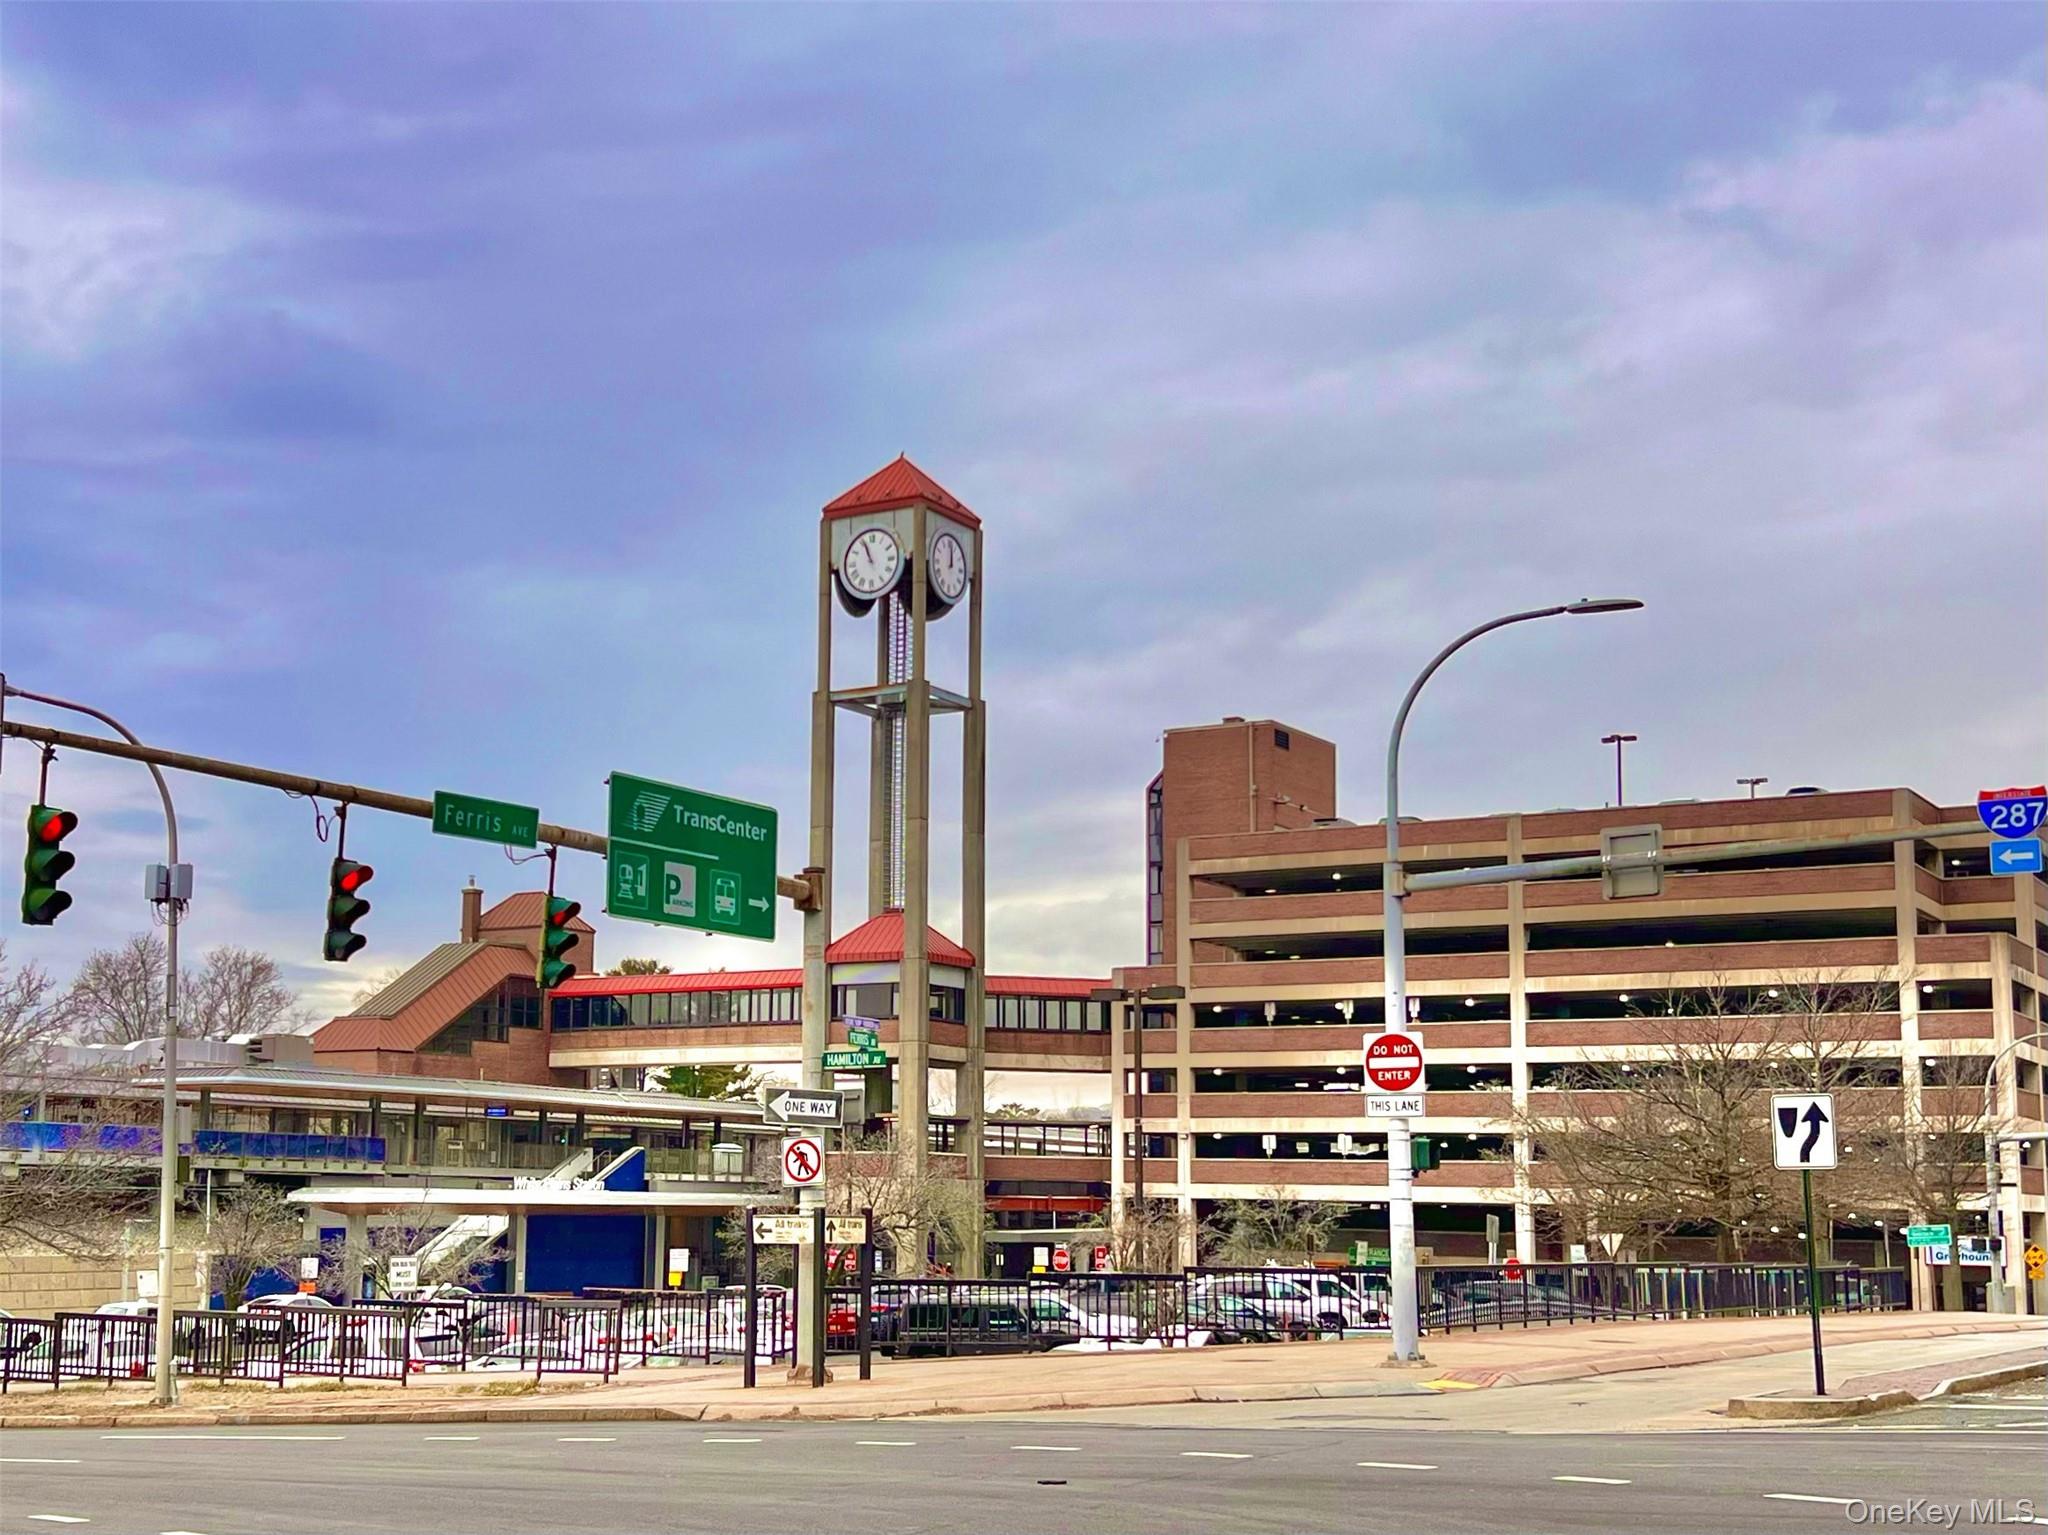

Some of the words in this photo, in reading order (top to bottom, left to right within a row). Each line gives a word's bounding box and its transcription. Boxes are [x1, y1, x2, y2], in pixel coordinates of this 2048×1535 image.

[445, 803, 502, 833] Ferris
[511, 825, 529, 838] AVE
[1990, 802, 2044, 829] 287
[673, 804, 767, 842] TransCenter
[1373, 1045, 1388, 1055] DO
[1393, 1044, 1413, 1055] NOT
[826, 1053, 869, 1066] HAMILTON
[1377, 1070, 1411, 1081] ENTER
[784, 1100, 805, 1112] ONE
[810, 1101, 833, 1114] WAY
[1370, 1100, 1391, 1111] THIS
[1395, 1100, 1420, 1111] LANE
